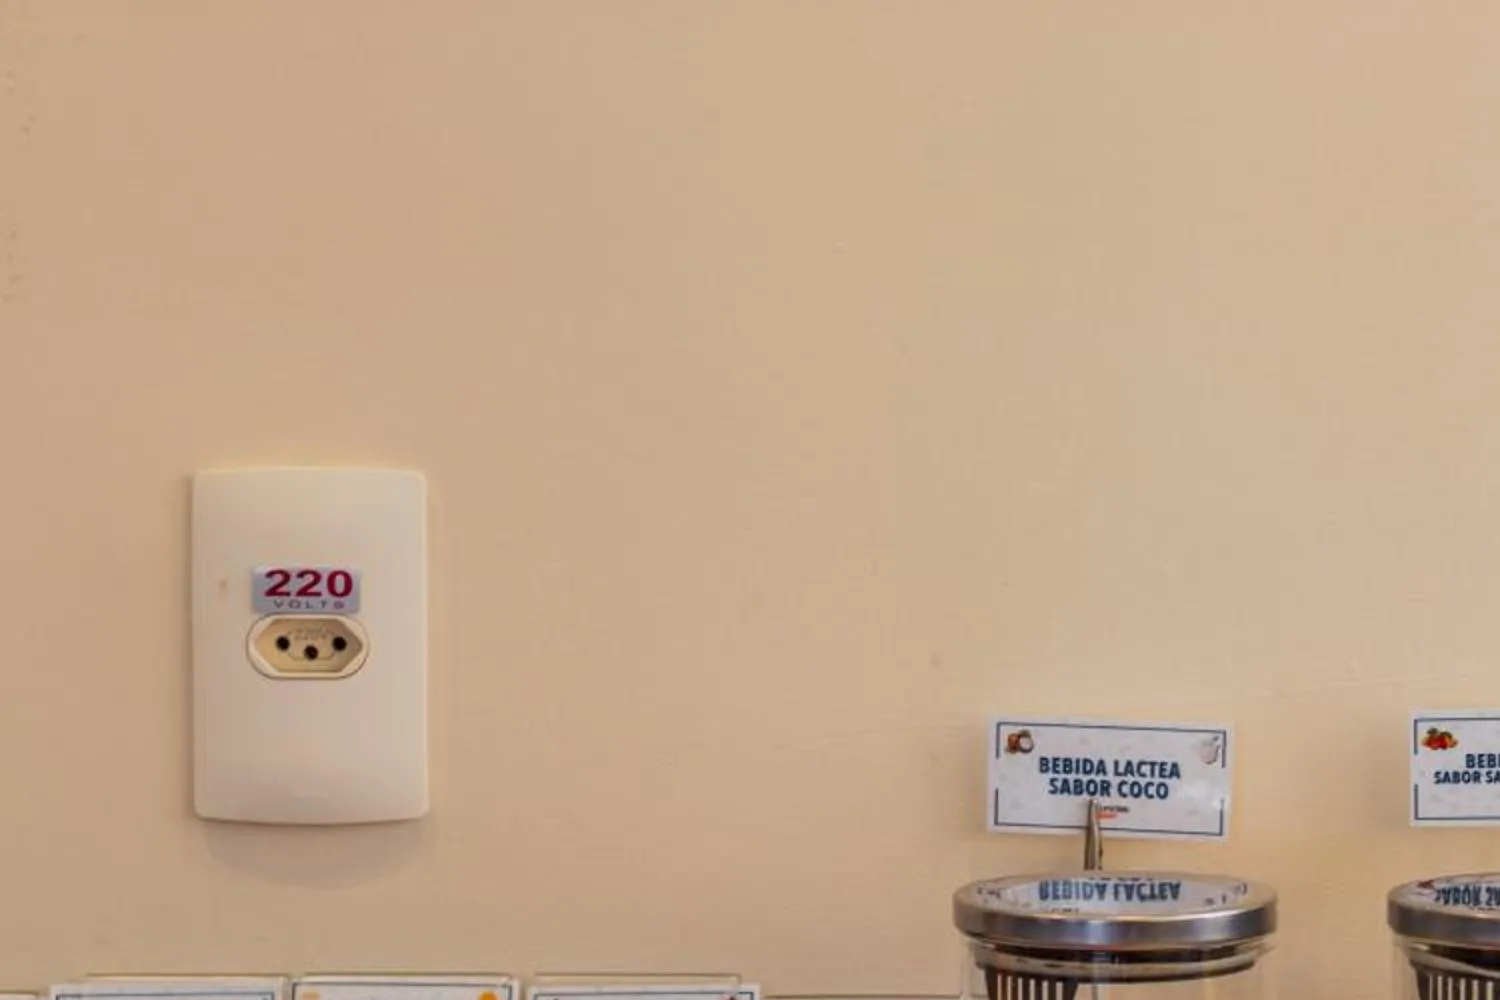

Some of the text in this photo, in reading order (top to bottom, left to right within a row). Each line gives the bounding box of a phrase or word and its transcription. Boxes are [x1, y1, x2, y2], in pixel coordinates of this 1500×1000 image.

[264, 569, 353, 598] 220
[273, 600, 345, 610] VOLTS
[1039, 756, 1181, 781] BEBIDA LACTEA
[1434, 770, 1482, 785] SABOR
[1048, 776, 1169, 800] SABOR COCO
